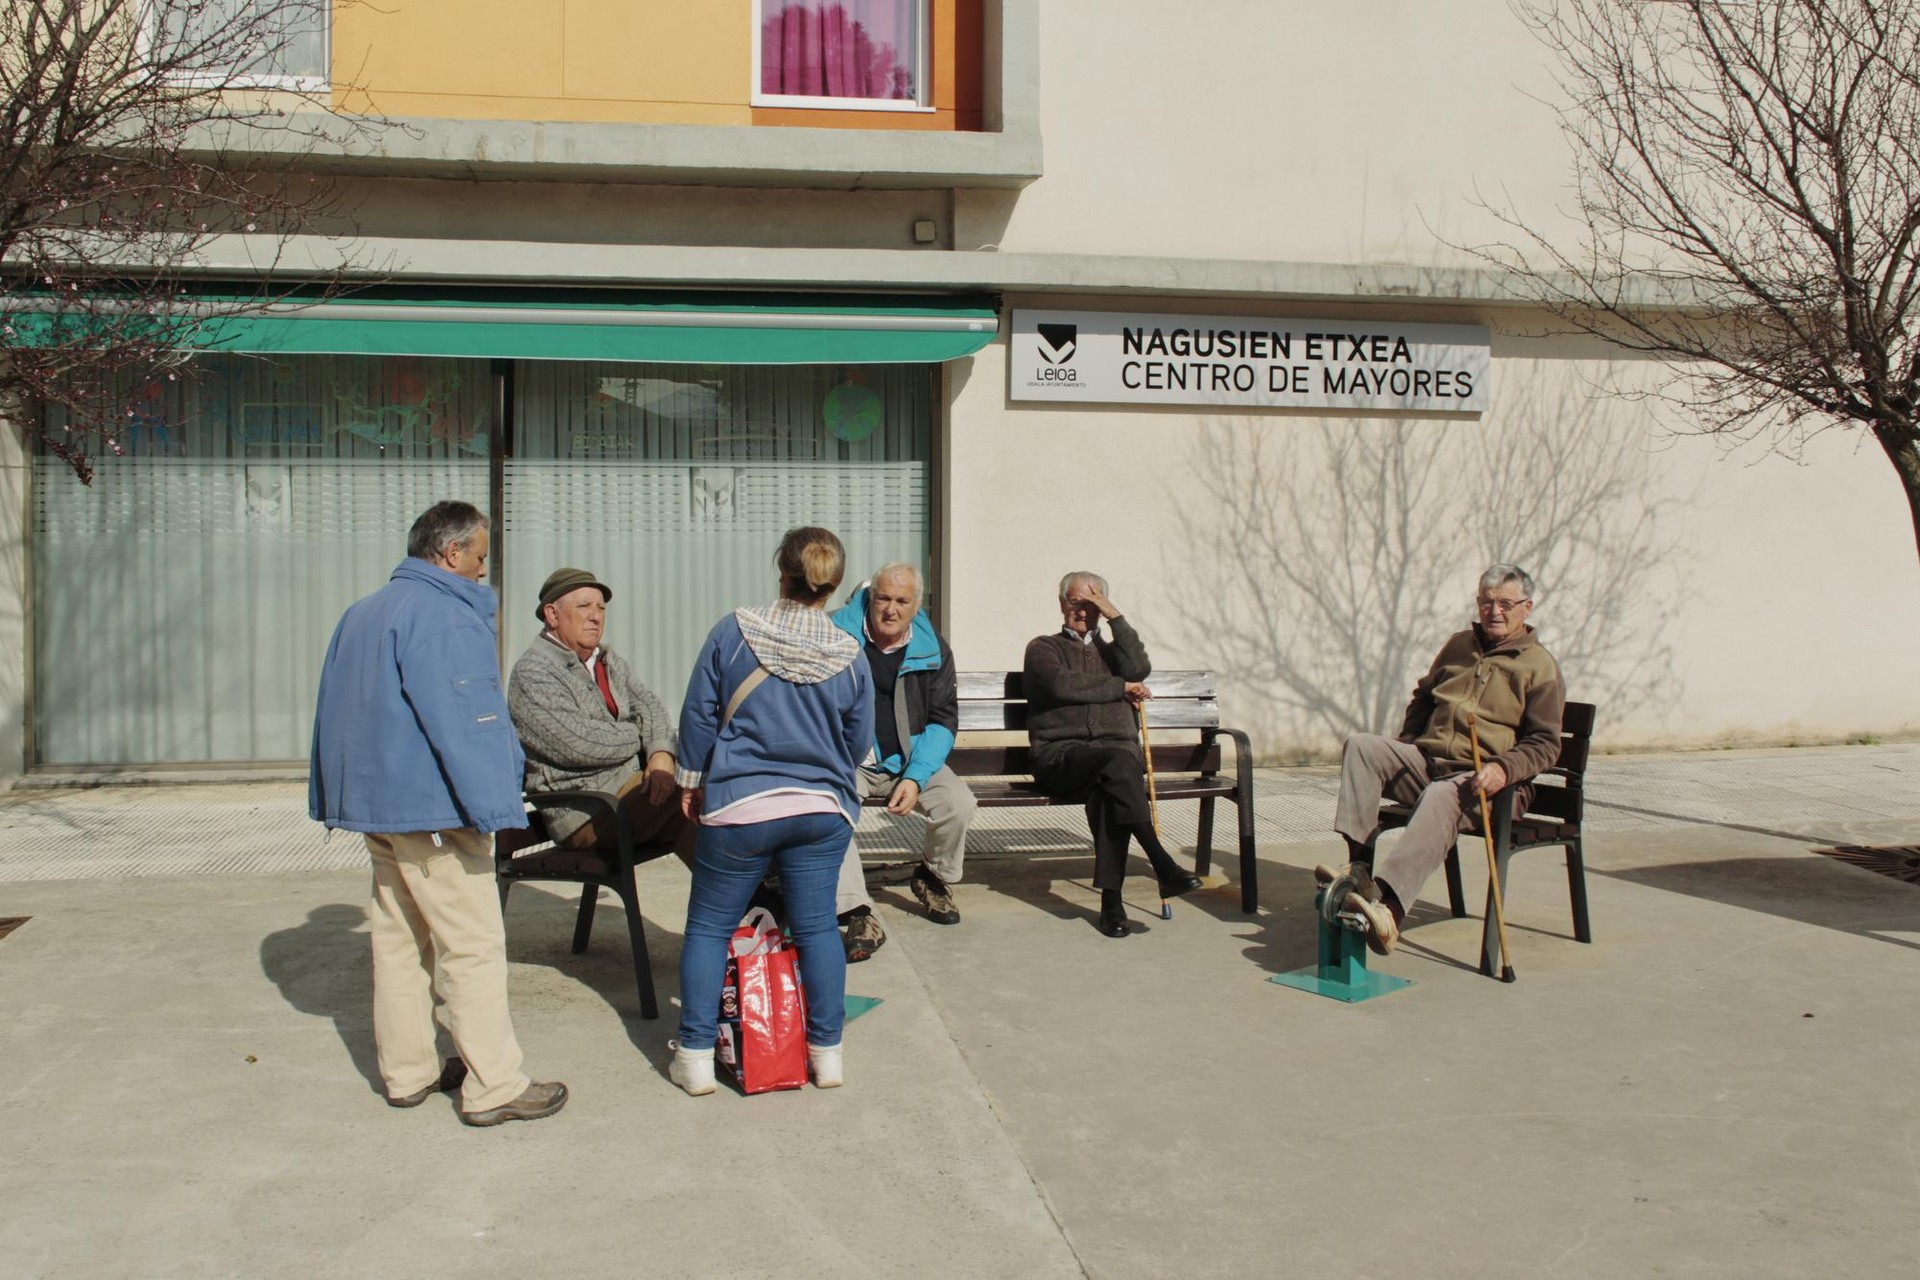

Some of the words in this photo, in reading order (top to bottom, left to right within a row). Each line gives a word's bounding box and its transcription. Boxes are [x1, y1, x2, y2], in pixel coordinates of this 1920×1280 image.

[1123, 327, 1291, 359] NAGUSIEN
[1306, 333, 1412, 362] ETXEA
[1036, 368, 1077, 382] Leioa
[1122, 361, 1255, 392] CENTRO
[1269, 365, 1309, 393] DE
[1323, 367, 1474, 398] MAYORES
